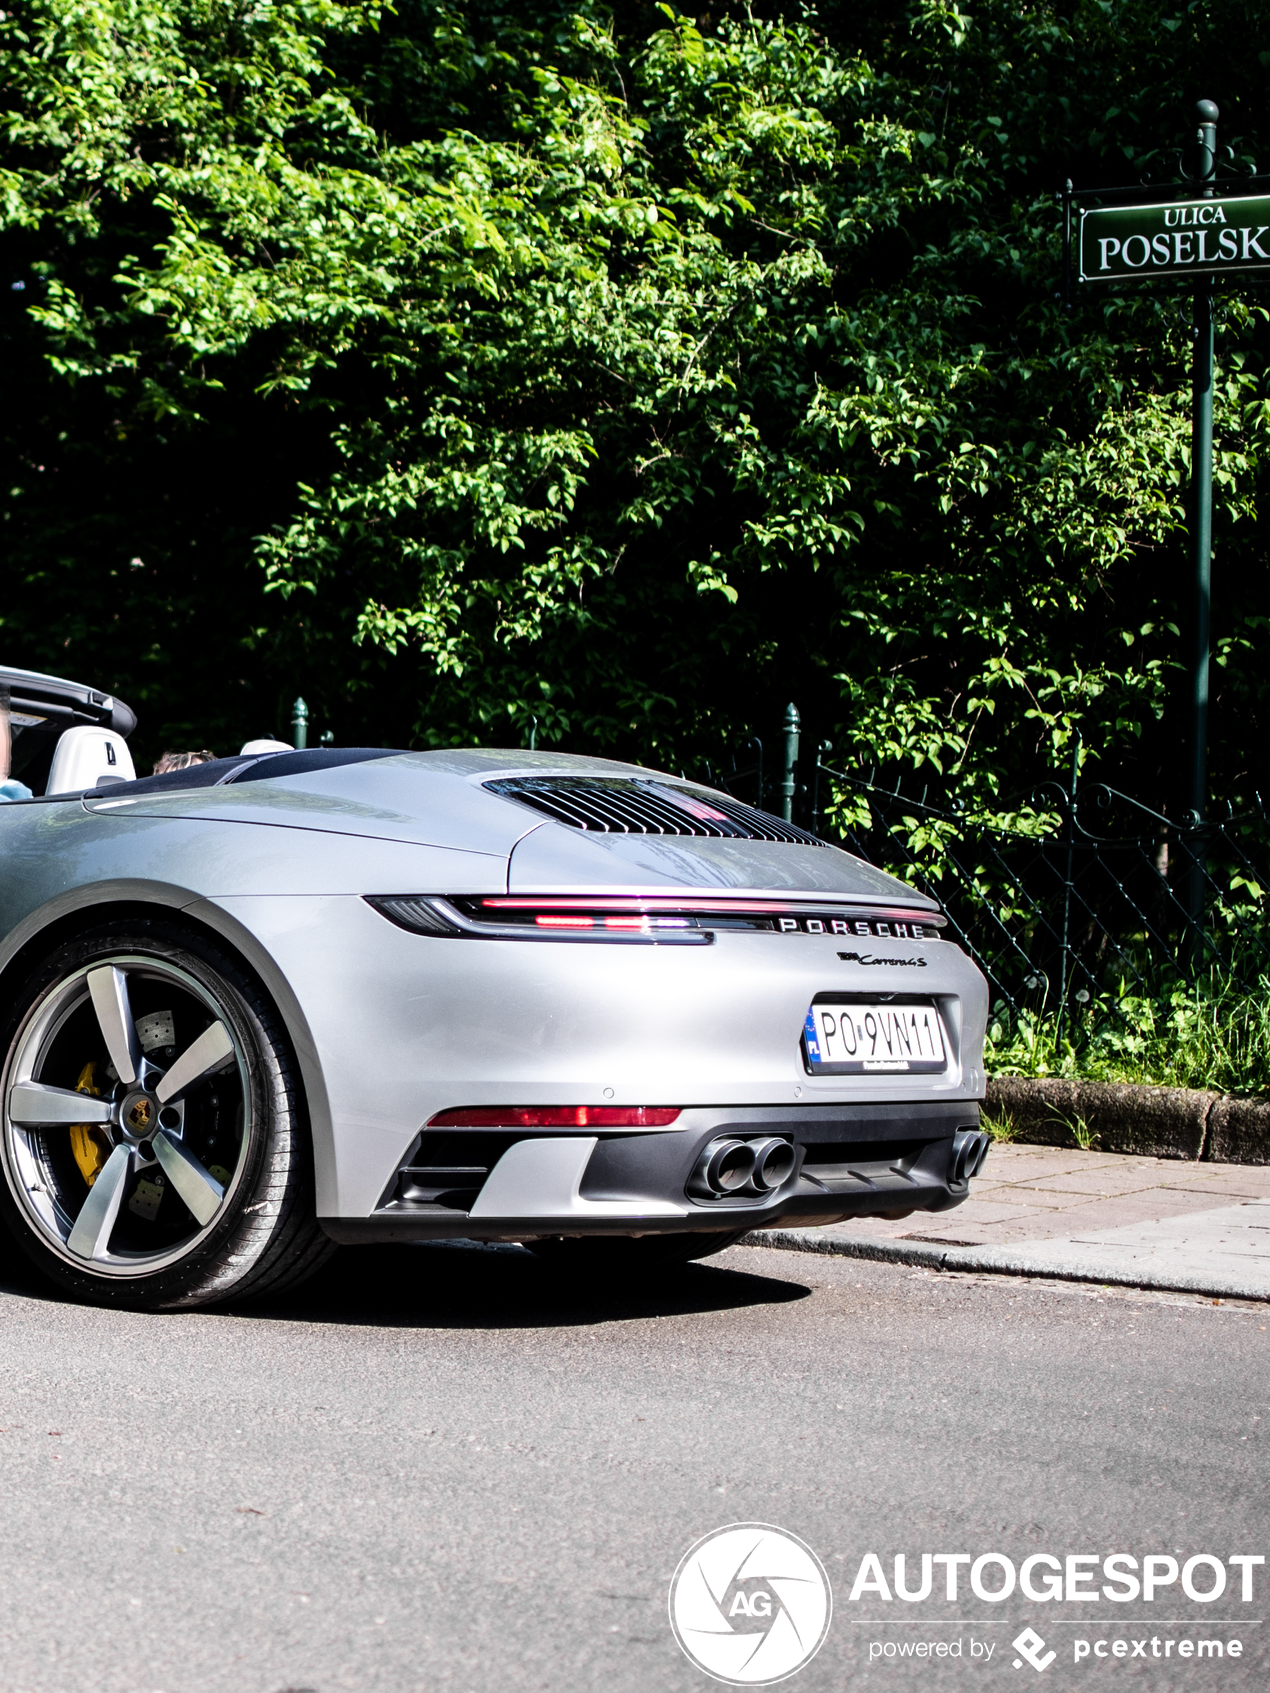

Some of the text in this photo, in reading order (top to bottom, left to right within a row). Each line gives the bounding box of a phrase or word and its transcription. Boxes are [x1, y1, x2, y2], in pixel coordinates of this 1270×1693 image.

[1164, 206, 1227, 227] ULICA
[1098, 226, 1270, 270] POSELSK
[778, 917, 925, 940] PORSCHE
[807, 1041, 820, 1055] PL
